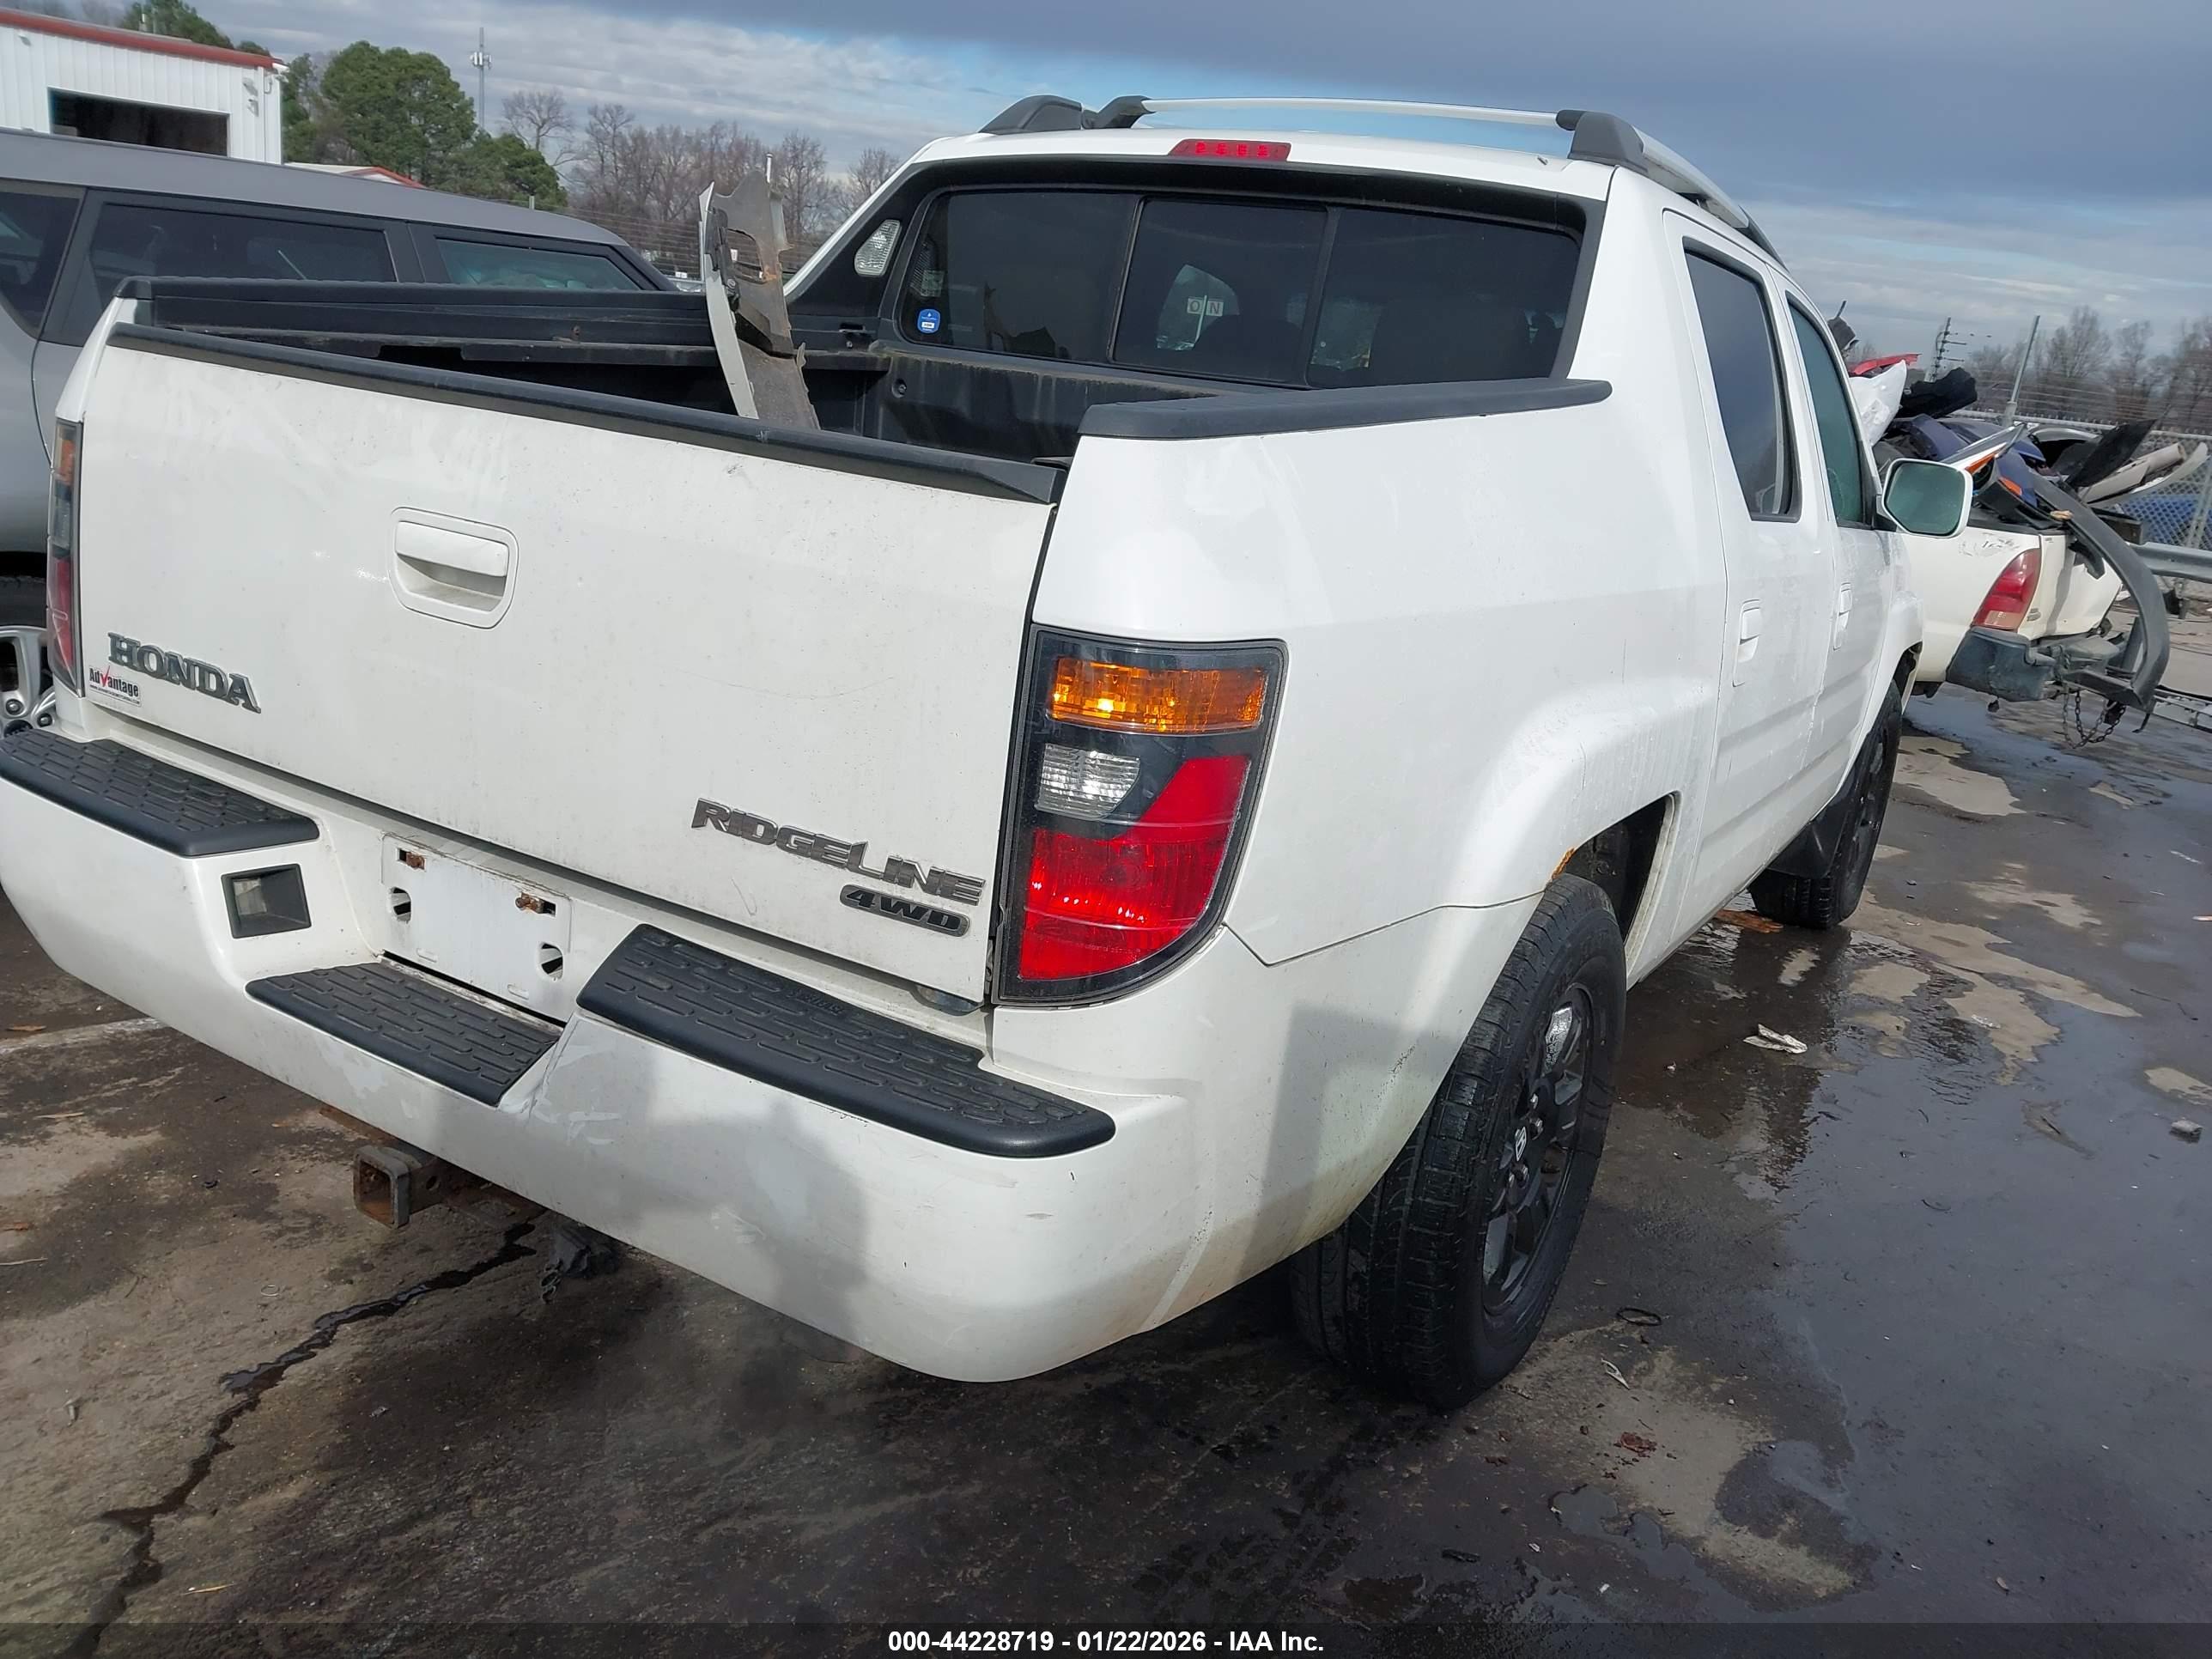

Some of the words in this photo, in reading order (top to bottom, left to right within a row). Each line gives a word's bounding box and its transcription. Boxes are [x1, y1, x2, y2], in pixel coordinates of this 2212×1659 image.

[89, 665, 139, 697] Advantage
[107, 632, 261, 714] HONDA
[691, 798, 986, 906] RIDGELINE
[846, 890, 961, 932] 4WD
